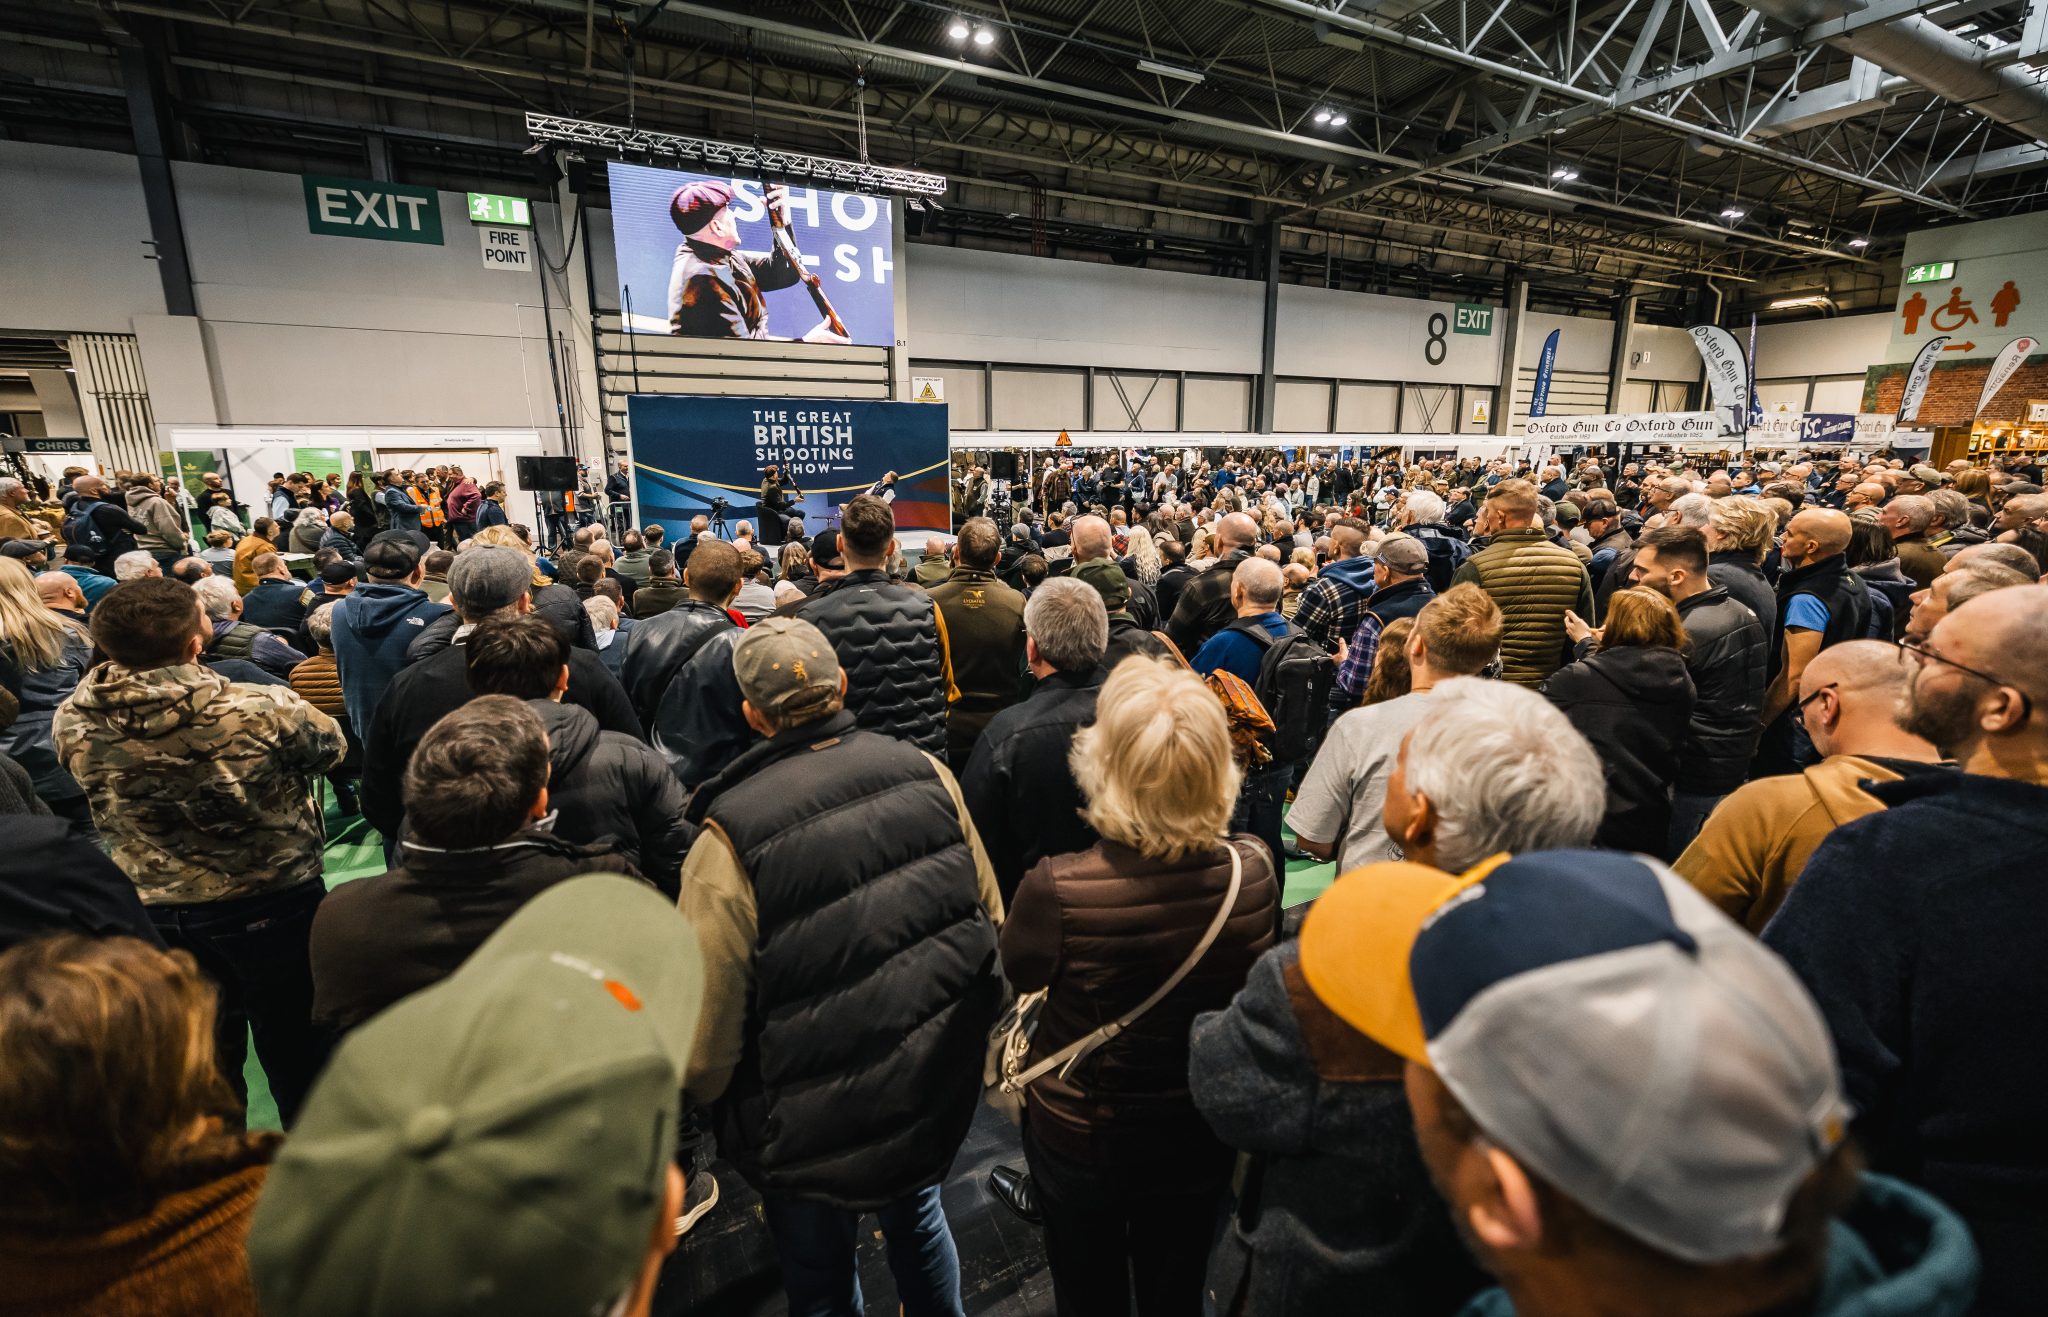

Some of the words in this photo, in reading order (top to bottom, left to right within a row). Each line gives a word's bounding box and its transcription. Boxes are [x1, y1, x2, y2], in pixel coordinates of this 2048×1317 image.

[316, 186, 428, 231] EXIT
[731, 178, 892, 231] SHO
[489, 231, 520, 246] FIRE
[485, 248, 526, 264] POINT
[1457, 308, 1490, 329] EXIT
[1425, 312, 1448, 366] 8
[1694, 326, 1725, 359] Oxford
[1721, 360, 1738, 383] Gun
[1734, 384, 1747, 400] Co
[1904, 375, 1922, 406] Oxford
[1919, 354, 1934, 373] Gun
[753, 410, 788, 422] THE
[796, 411, 851, 423] GREAT
[1626, 419, 1675, 432] Oxford
[1681, 418, 1714, 431] Gun
[753, 425, 853, 445] BRITISH
[1527, 422, 1567, 434] Oxford
[1573, 421, 1599, 433] Gun
[1604, 420, 1621, 431] Co
[1802, 417, 1822, 438] TSC
[35, 441, 80, 450] CHRIS
[755, 447, 854, 461] SHOOTING
[793, 463, 830, 474] HOW
